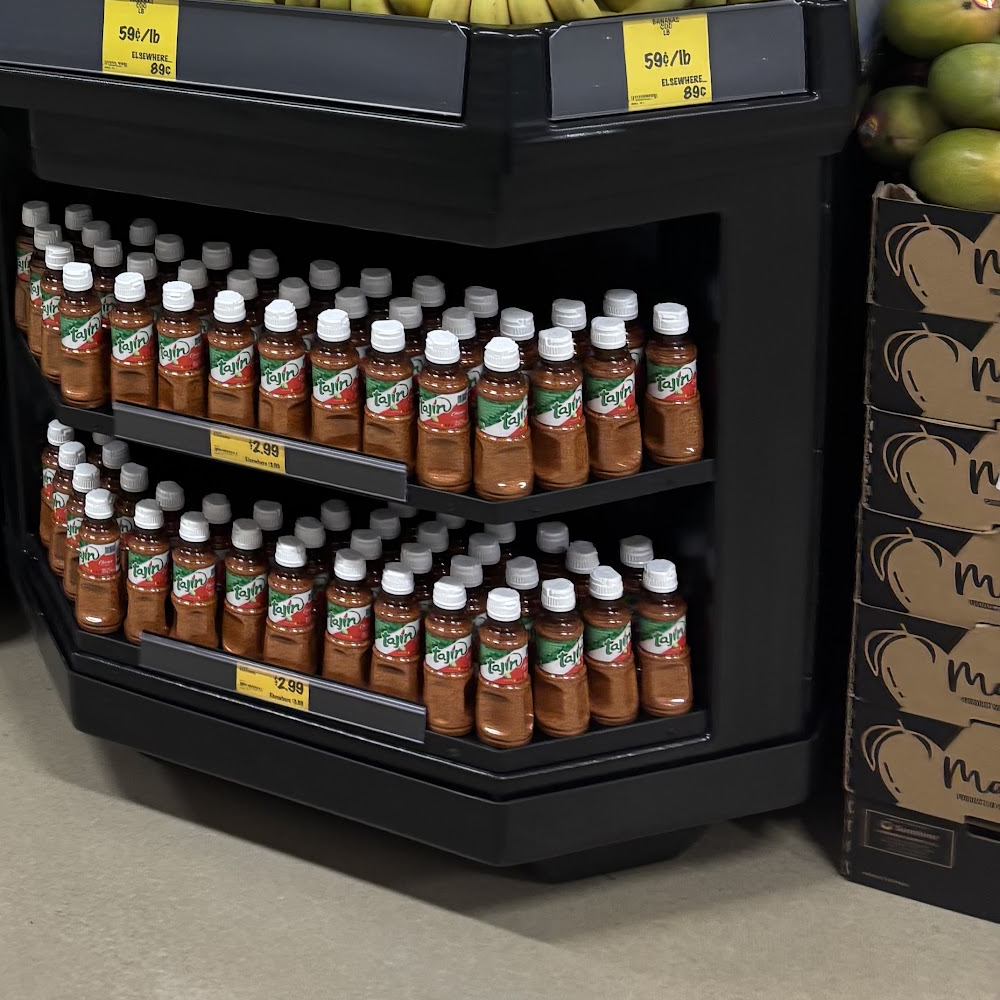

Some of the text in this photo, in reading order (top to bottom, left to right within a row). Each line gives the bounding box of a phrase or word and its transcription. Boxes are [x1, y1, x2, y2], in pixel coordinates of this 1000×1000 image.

[118, 25, 160, 44] 59¢/lb
[644, 49, 691, 70] 59¢/lb
[249, 439, 279, 458] $2.99
[275, 675, 304, 695] $2.99
